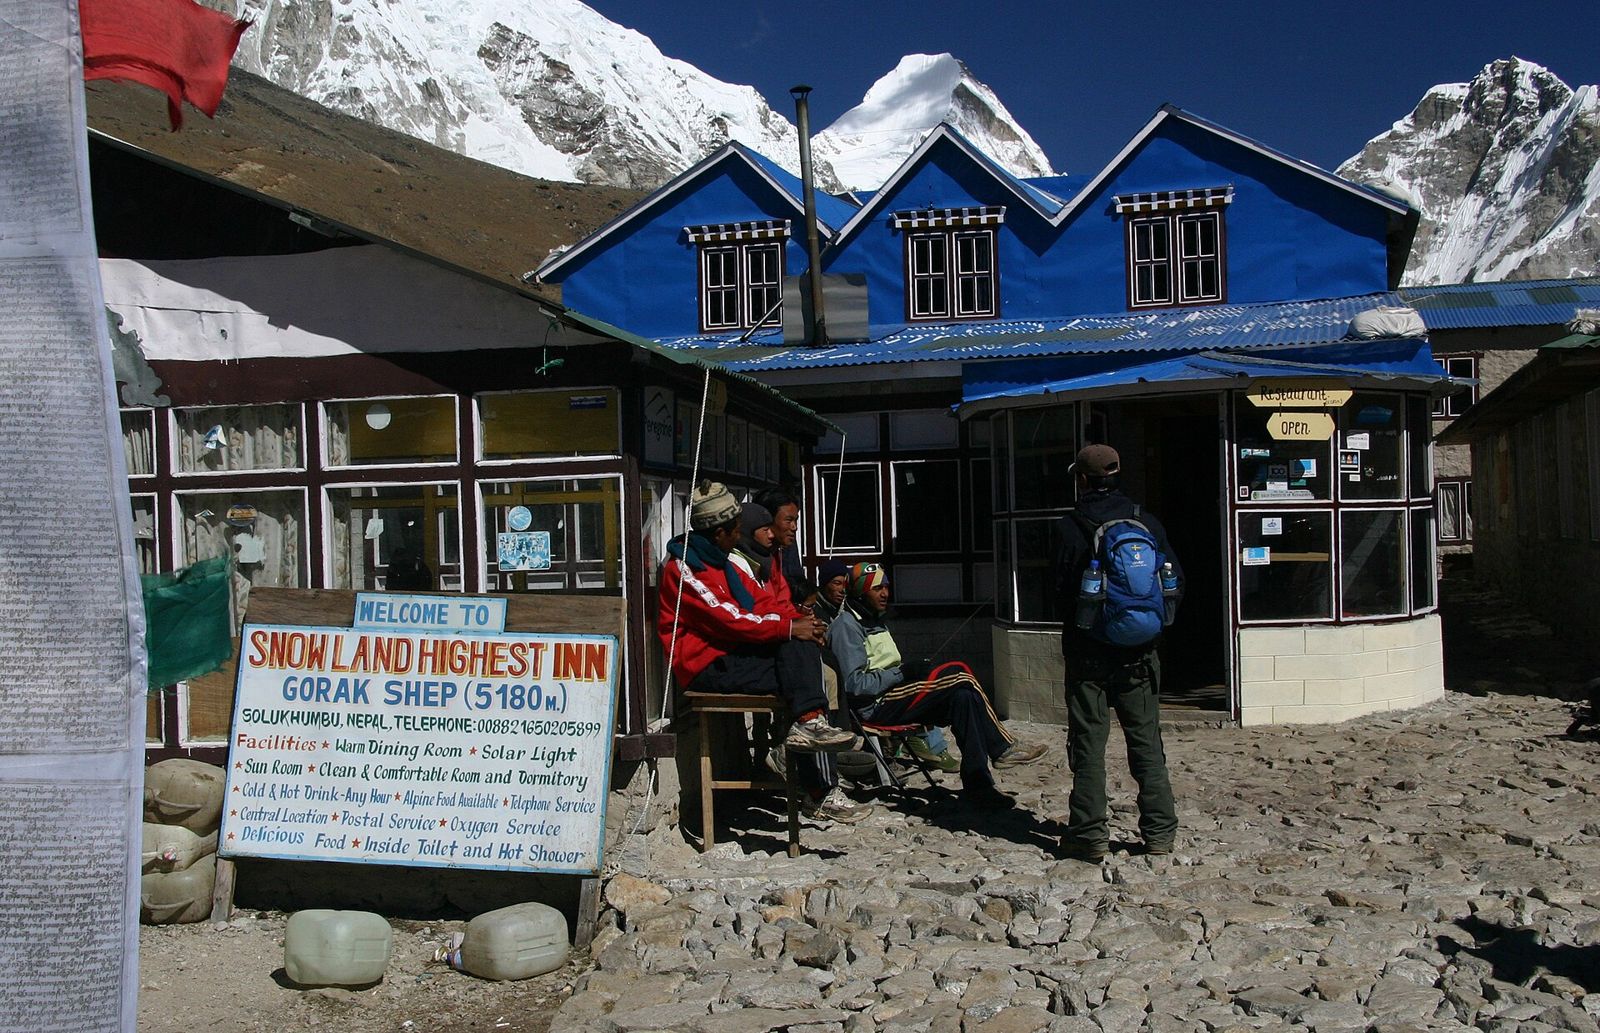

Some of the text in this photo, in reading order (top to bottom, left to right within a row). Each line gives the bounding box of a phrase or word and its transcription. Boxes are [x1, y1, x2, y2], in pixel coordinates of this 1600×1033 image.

[359, 601, 490, 626] WELCOME TO
[418, 639, 548, 681] HIGHEST
[552, 642, 608, 682] INN
[282, 676, 371, 704] GORAK
[384, 680, 457, 708] SHEP
[242, 708, 344, 730] SOLUKHUMBU,
[346, 713, 393, 733] NEPAL,
[236, 733, 578, 768] Facilities Warm Dining Room Solar Light
[244, 757, 588, 793] Sun Room Clean & Comfortable Room and Dormitory
[242, 782, 266, 798] Cold
[268, 785, 277, 800] &
[280, 783, 300, 799] Hot
[369, 788, 392, 804] Hour
[402, 790, 435, 810] Alpine
[435, 791, 456, 807] Food
[458, 792, 499, 809] Available
[510, 794, 551, 815] Telephone
[555, 796, 596, 814] Service
[240, 806, 561, 840] Central Location Postal Service Oxygen Service
[241, 825, 586, 864] Delicious Food Inside Toilet and Hot Shower
